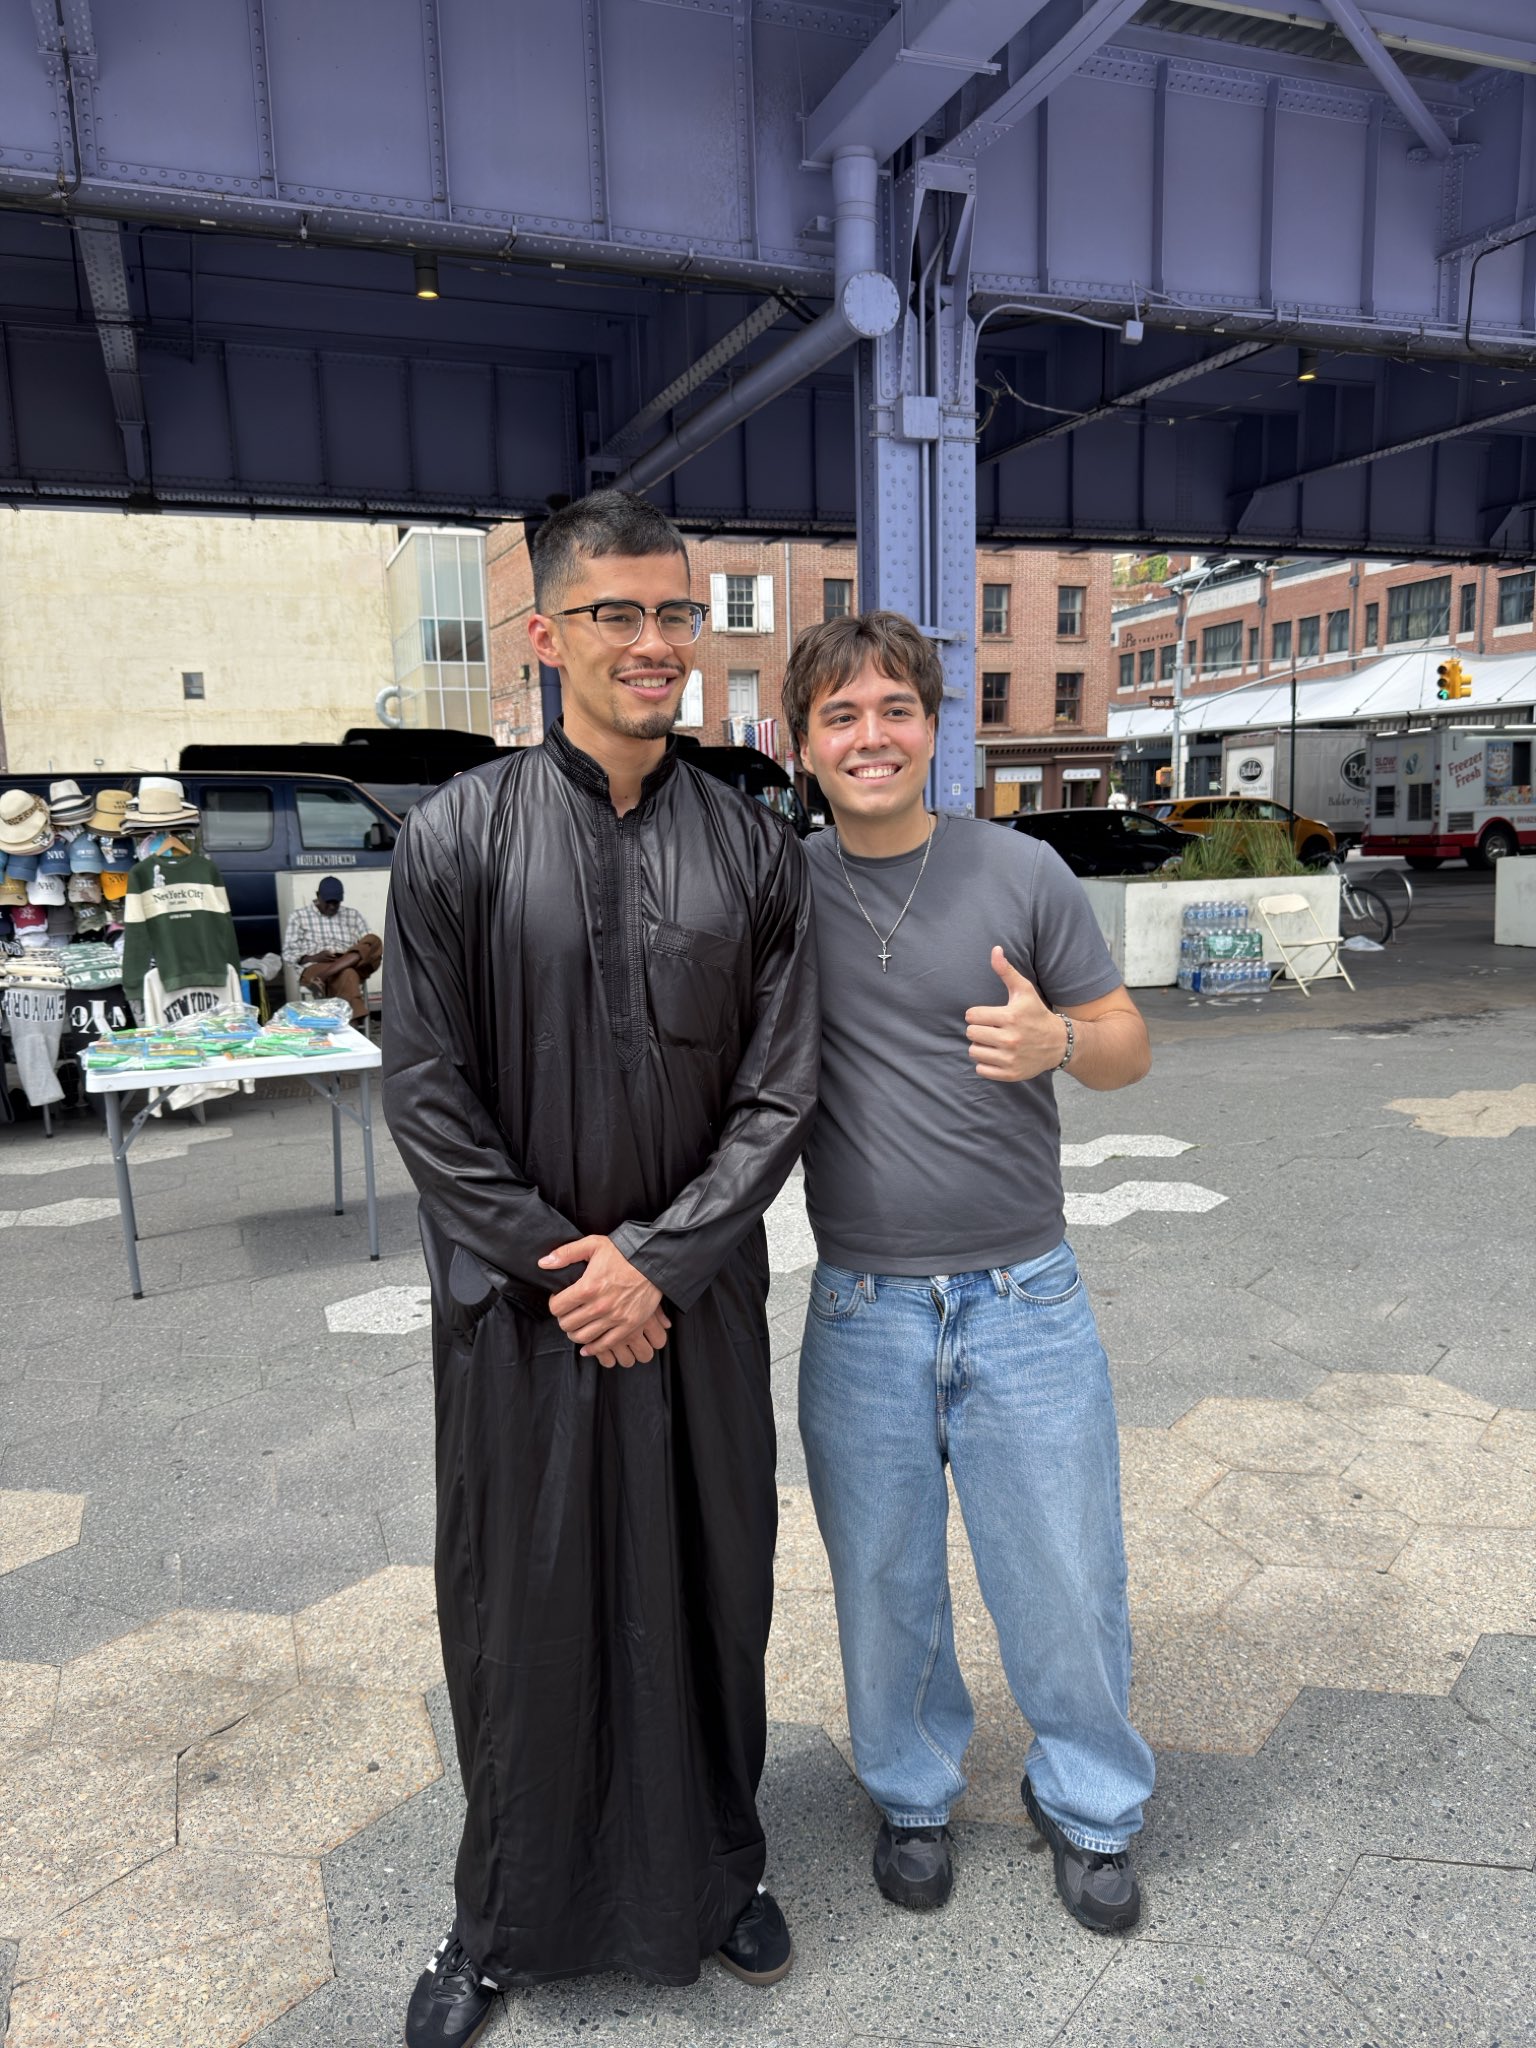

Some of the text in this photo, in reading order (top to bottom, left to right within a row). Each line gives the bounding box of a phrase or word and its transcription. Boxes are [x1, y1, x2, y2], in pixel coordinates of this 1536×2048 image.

[1448, 752, 1483, 776] Freezer
[1455, 766, 1482, 788] Fresh
[47, 850, 65, 859] NYC
[168, 890, 186, 900] York
[187, 889, 204, 900] City
[79, 907, 96, 919] NYC
[71, 1000, 128, 1034] NYC
[163, 994, 190, 1023] NEW
